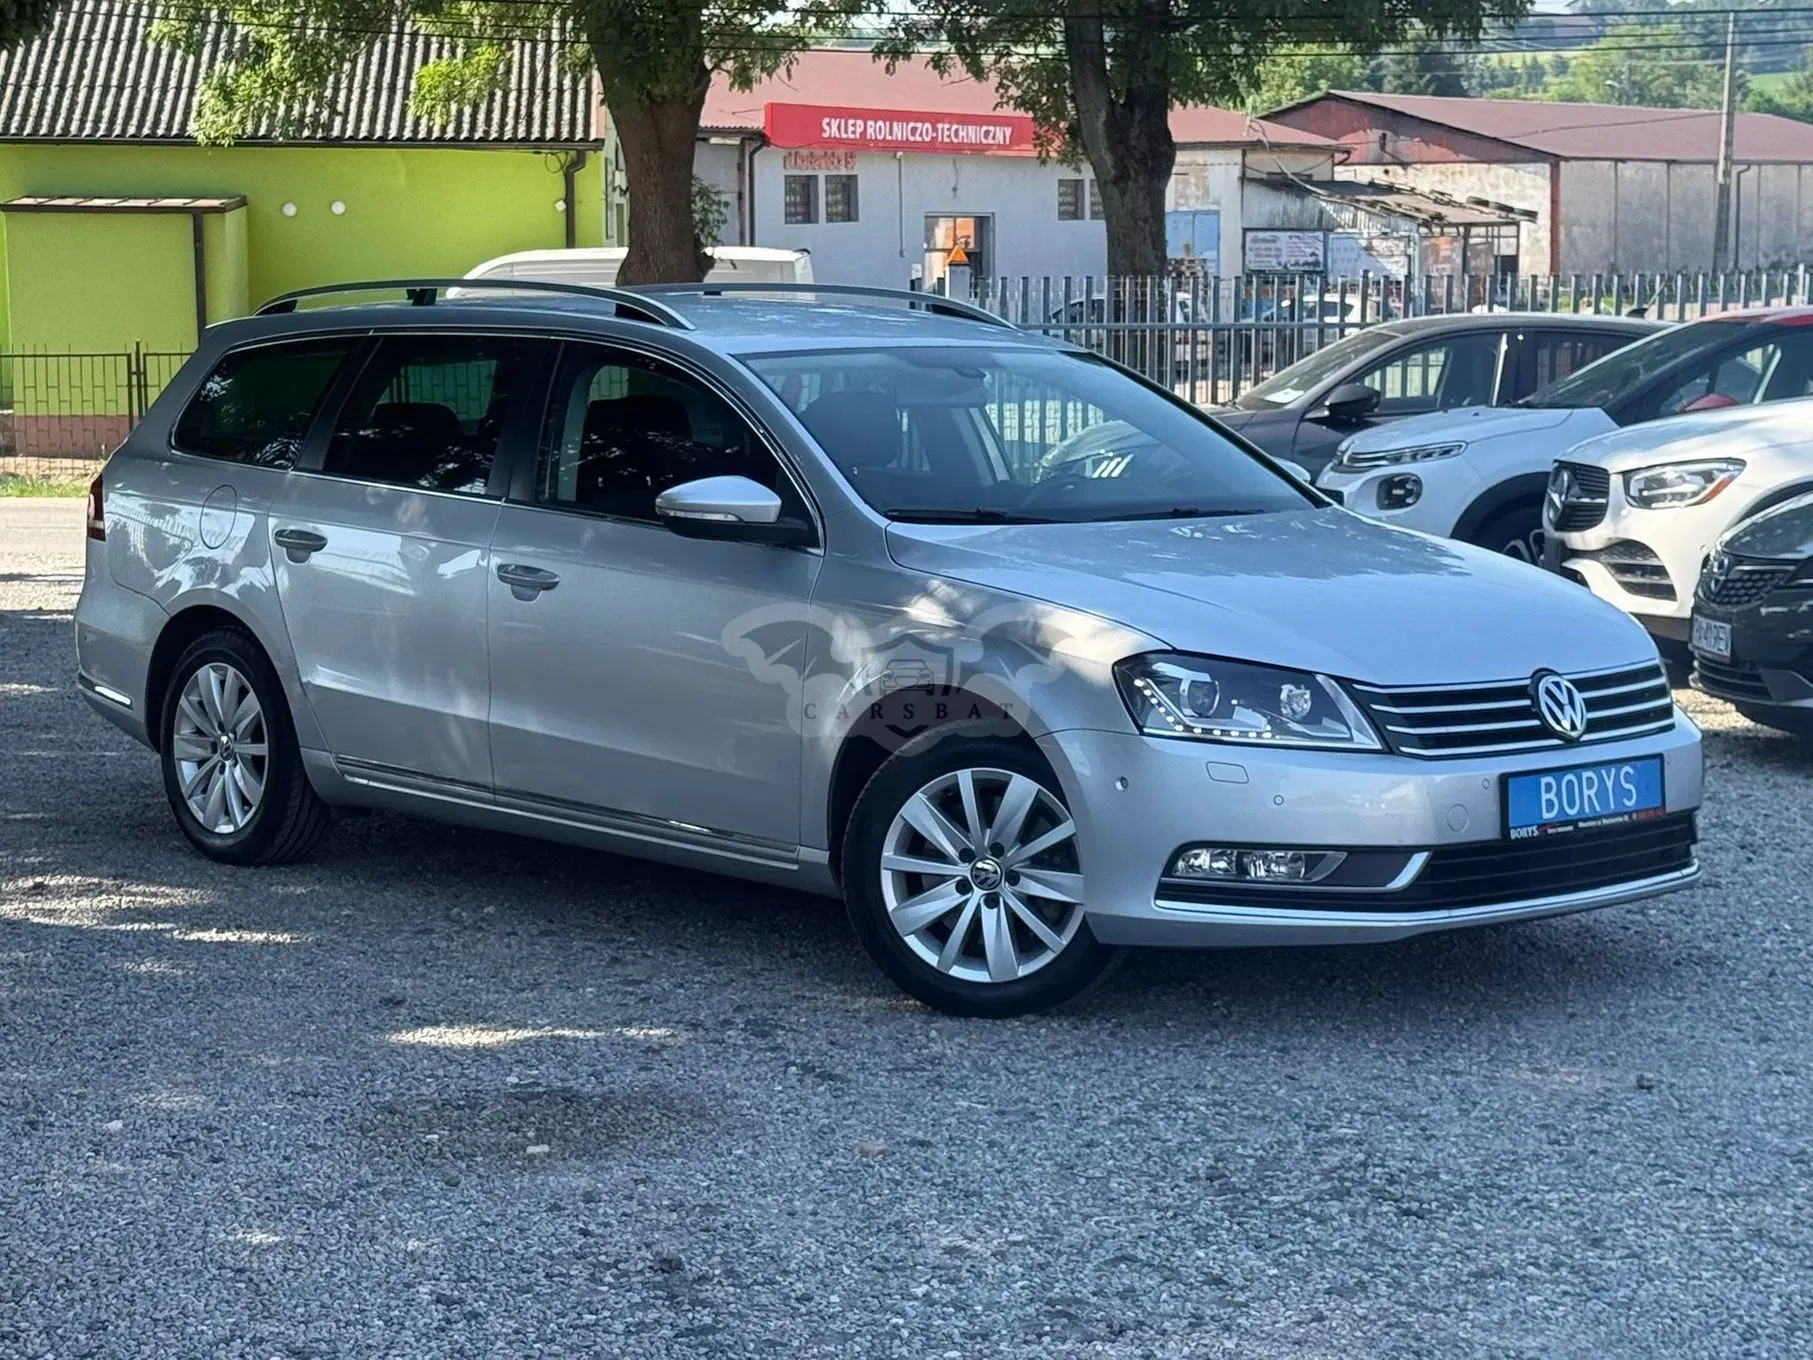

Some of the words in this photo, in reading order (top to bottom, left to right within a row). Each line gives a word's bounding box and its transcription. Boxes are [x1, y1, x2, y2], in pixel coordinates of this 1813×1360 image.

[821, 117, 865, 141] SKLEP
[867, 120, 1013, 146] ROLNICZO-TECHNICZNY
[1539, 765, 1637, 820] BORYS
[1510, 825, 1538, 840] BORYS
